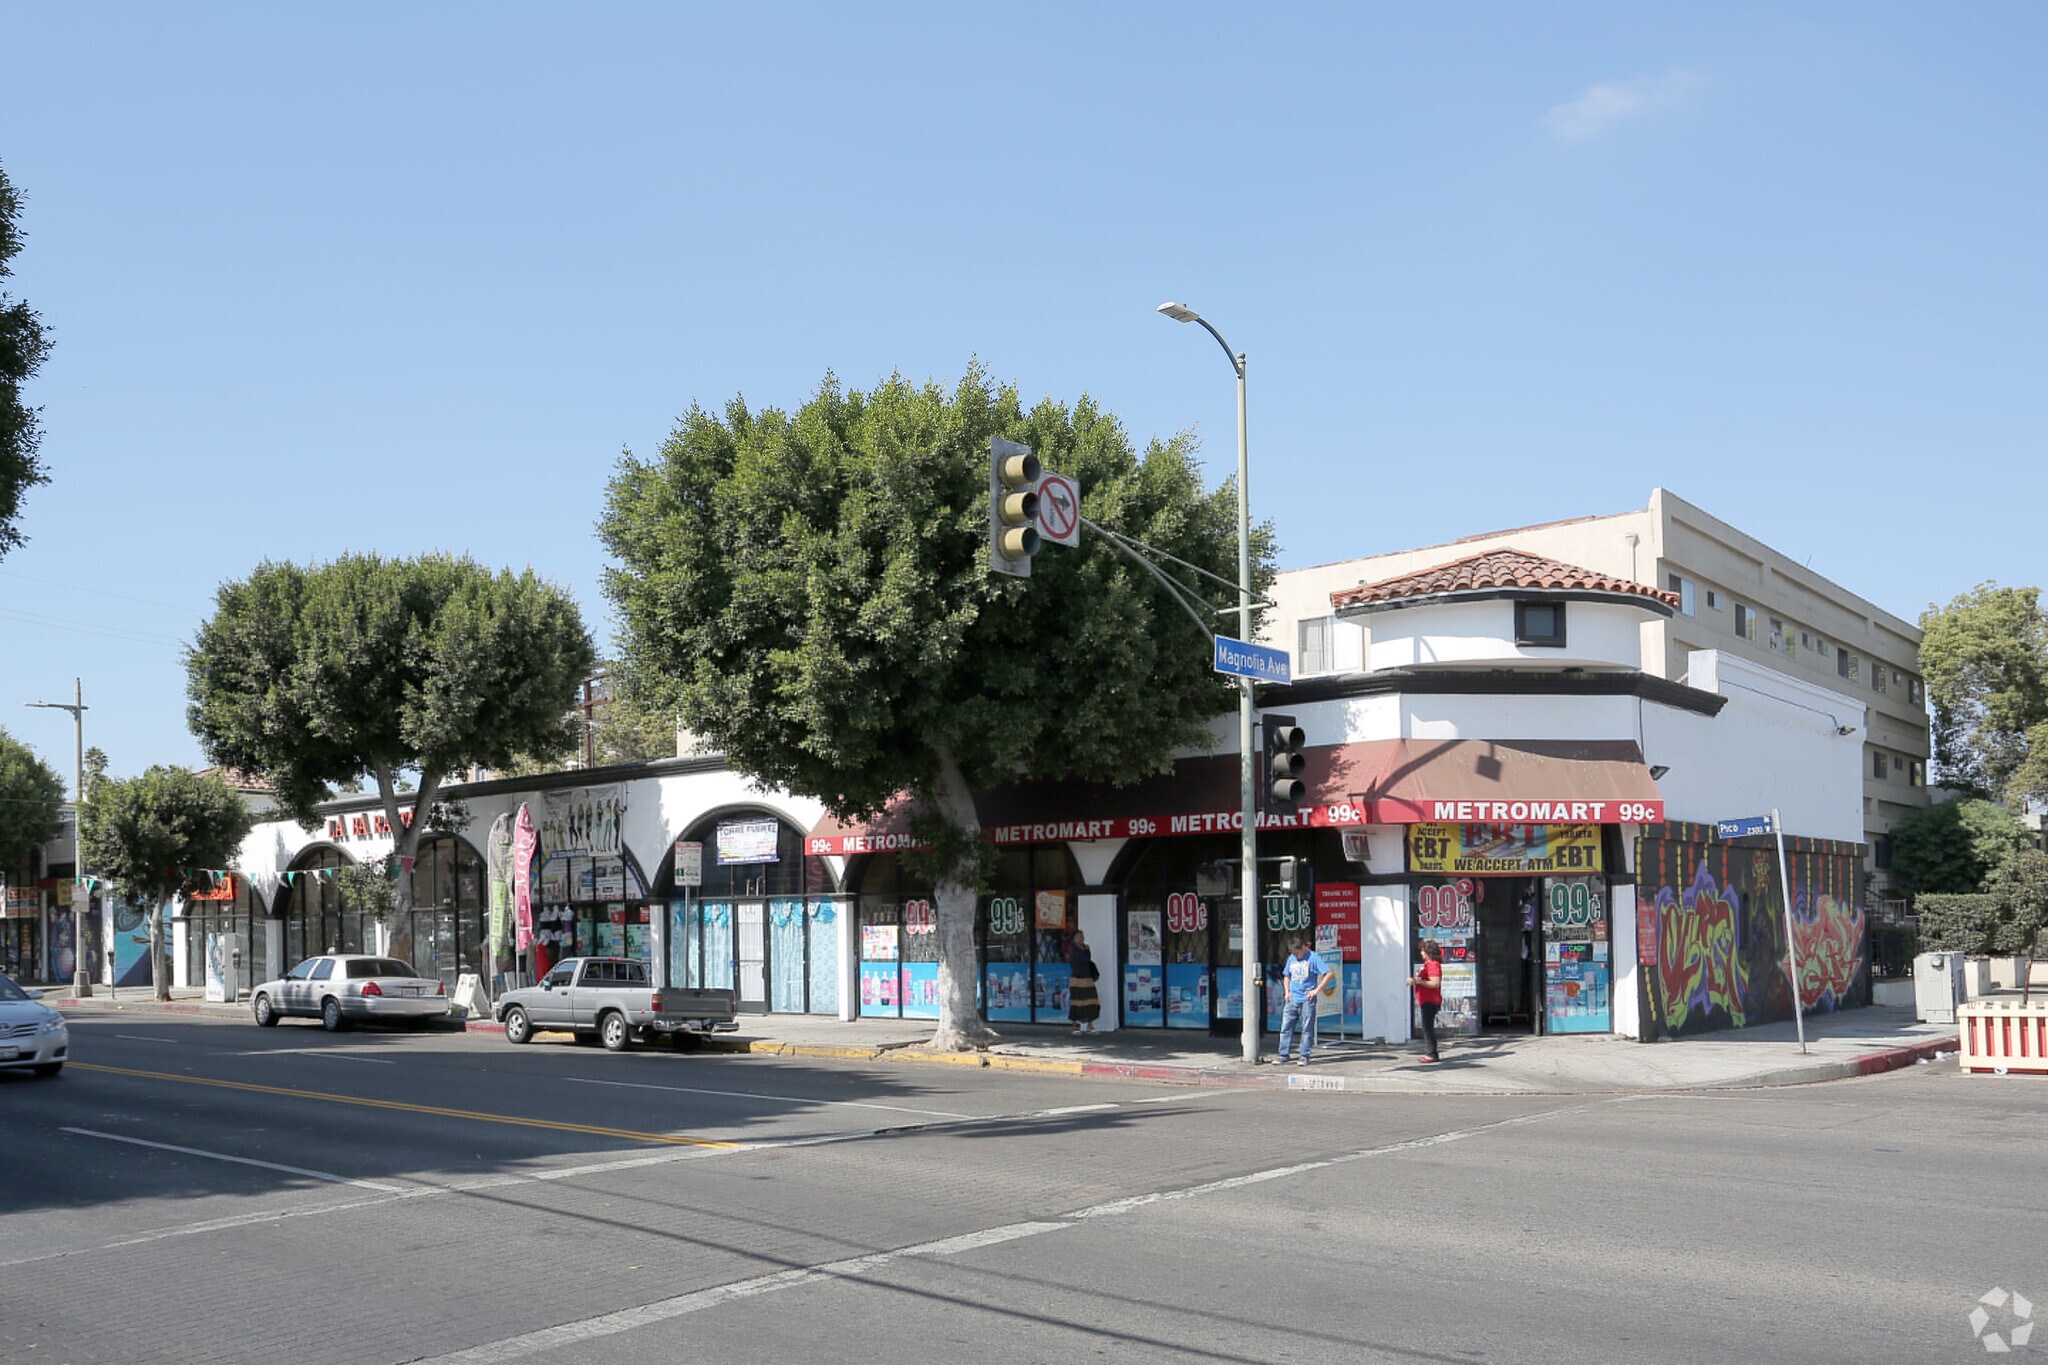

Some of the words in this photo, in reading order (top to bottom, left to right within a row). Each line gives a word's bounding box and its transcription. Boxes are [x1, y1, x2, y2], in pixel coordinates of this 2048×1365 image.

[1218, 645, 1265, 672] Magnolia
[1268, 656, 1286, 675] Ave
[1434, 801, 1606, 820] METROMART
[995, 819, 1114, 843] METROMART
[1720, 824, 1739, 833] Pico
[1414, 837, 1451, 859] EBT
[1555, 845, 1596, 867] EBT
[1454, 858, 1474, 870] WE
[1475, 858, 1522, 870] ACCEPT
[1527, 858, 1553, 870] ATM
[991, 898, 1025, 934] 99¢
[1167, 892, 1208, 932] 99¢
[1267, 889, 1311, 931] 99¢
[1418, 884, 1469, 929] 99¢
[1550, 882, 1601, 926] 99¢
